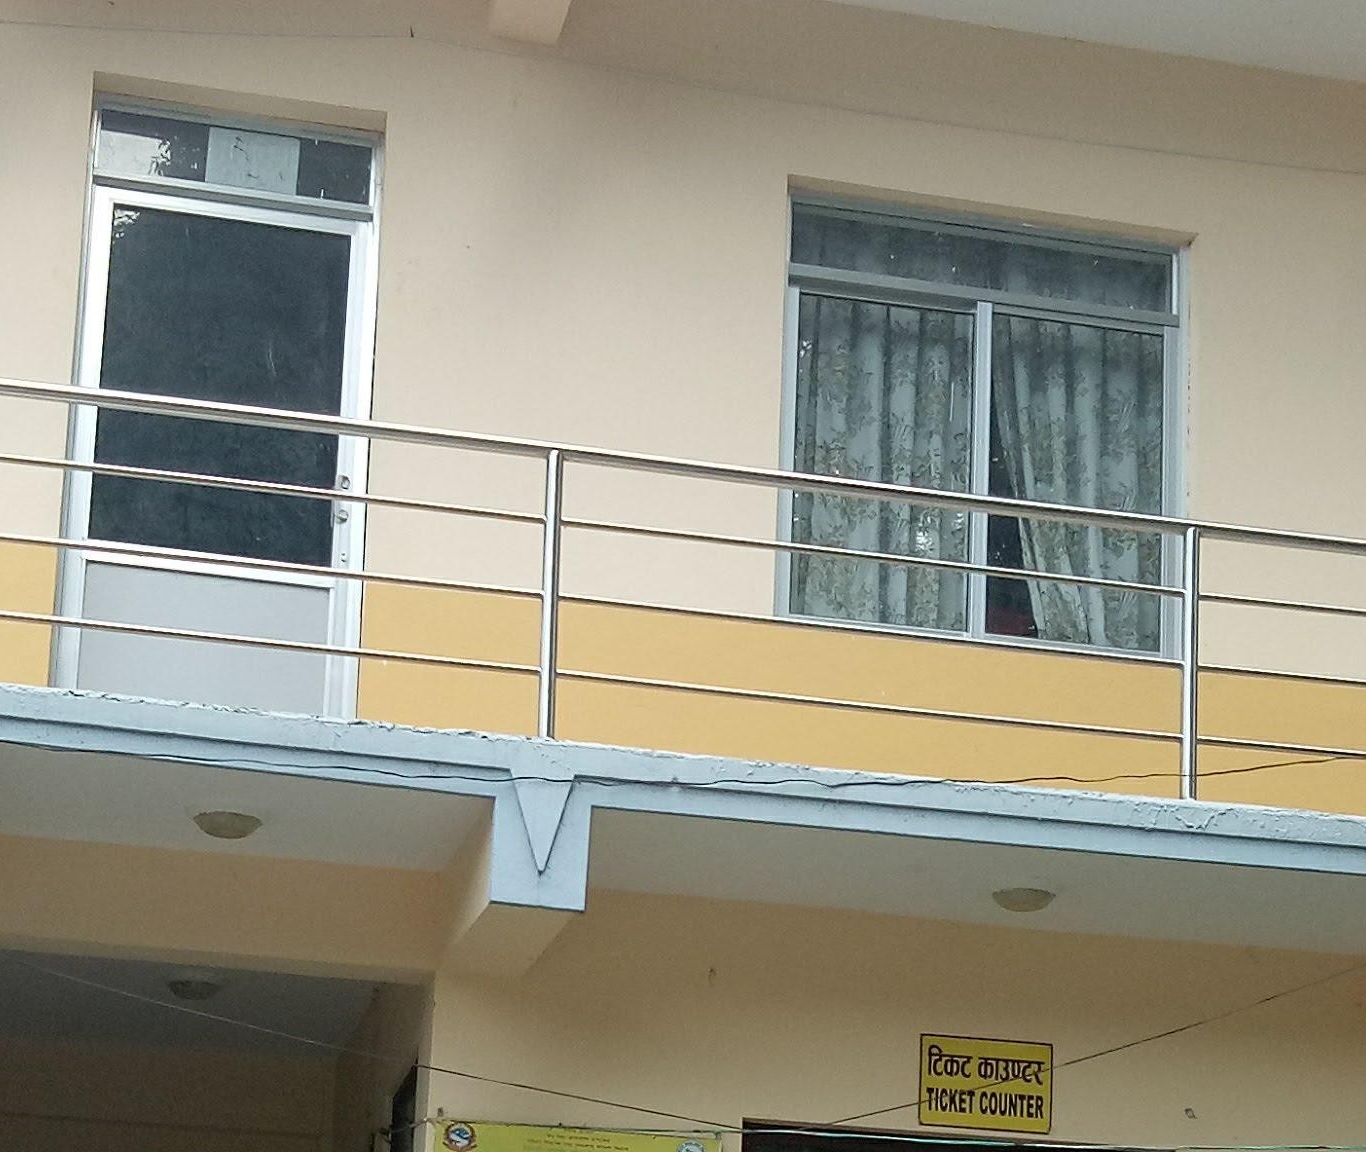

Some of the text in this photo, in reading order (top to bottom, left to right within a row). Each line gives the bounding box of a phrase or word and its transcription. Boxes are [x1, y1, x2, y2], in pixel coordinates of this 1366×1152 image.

[928, 1044, 1045, 1086] टिकट काउण्टर
[926, 1087, 1044, 1119] TICKET COUNTER
